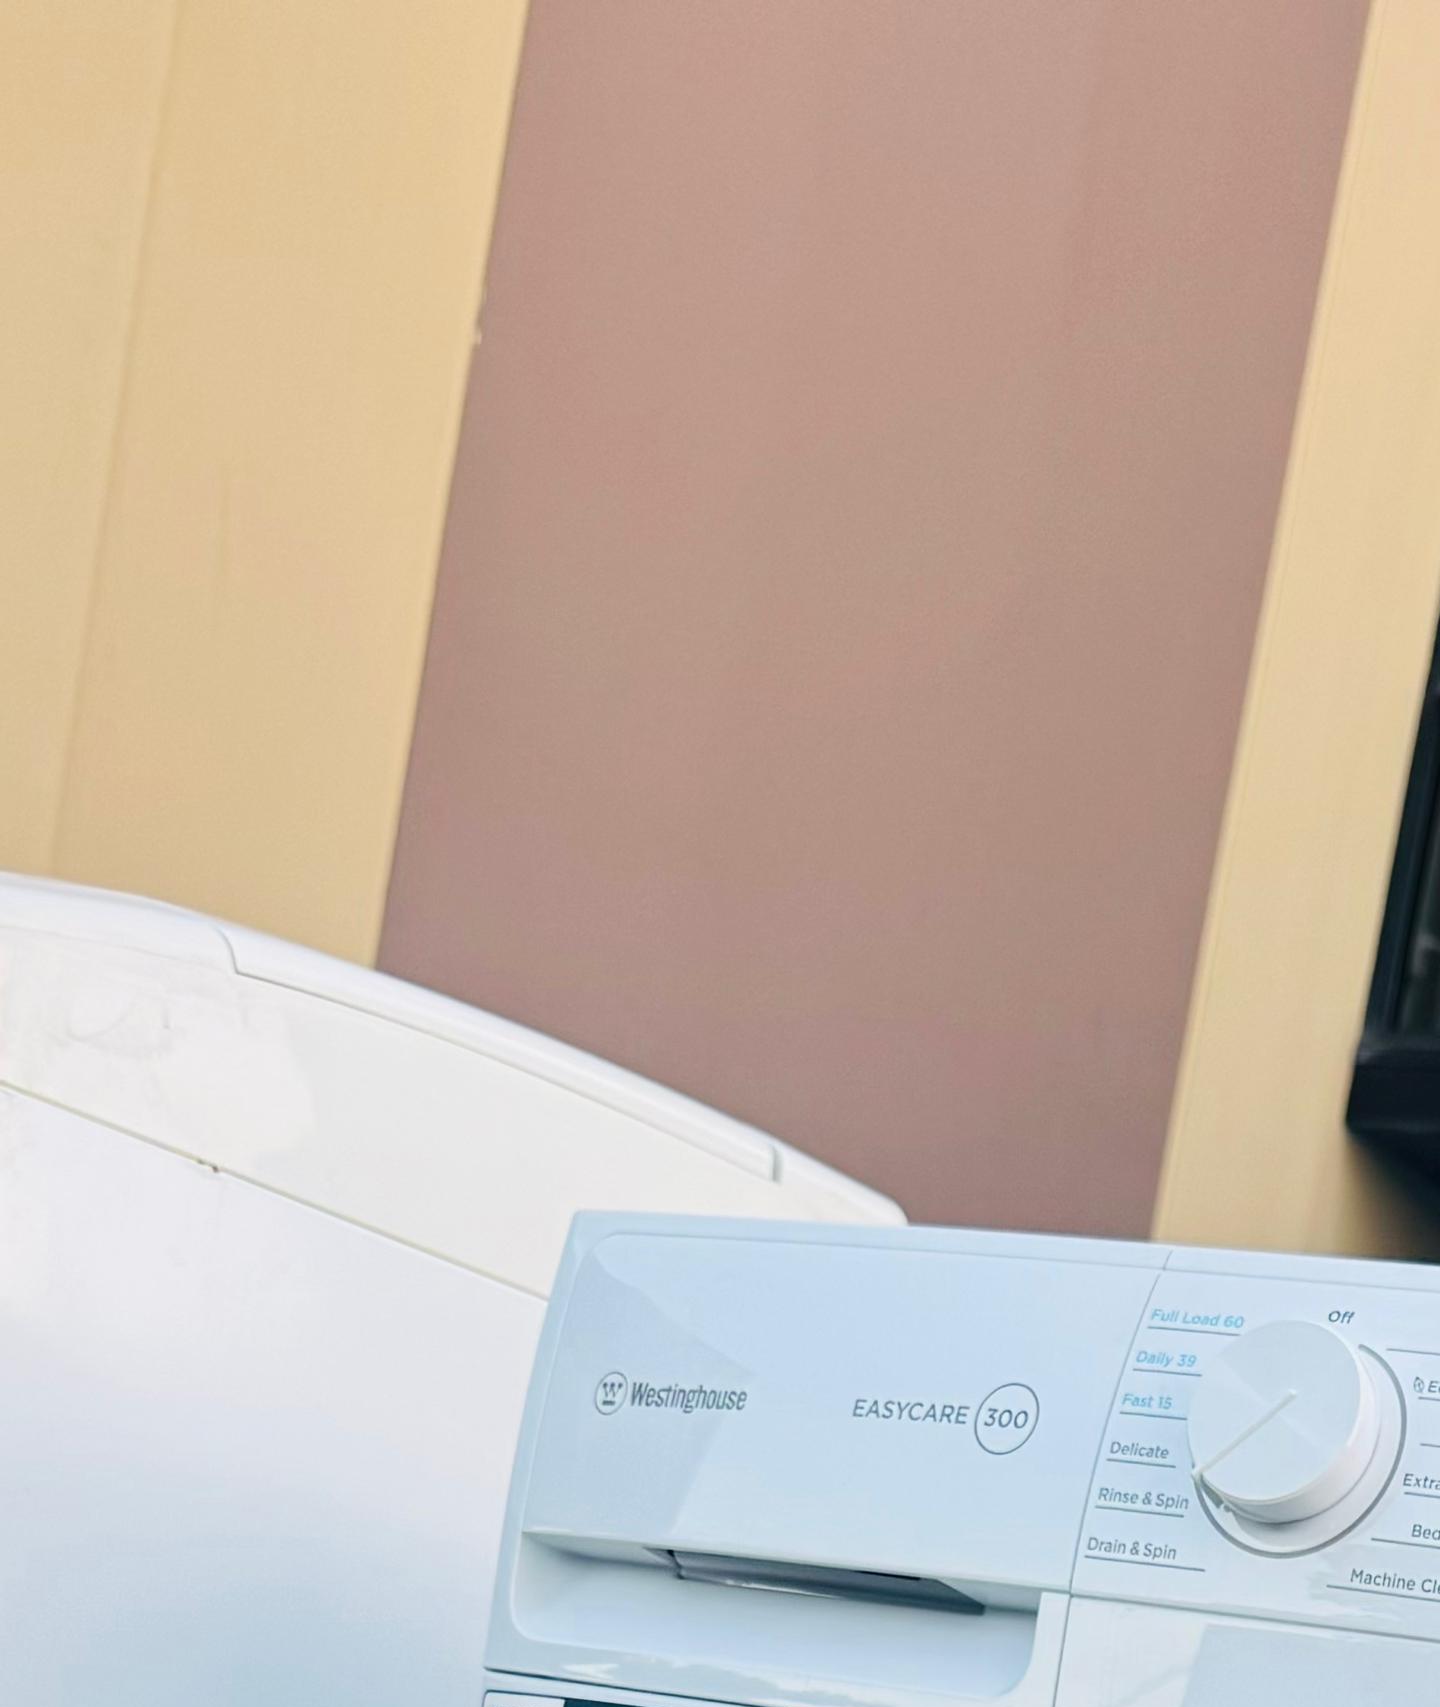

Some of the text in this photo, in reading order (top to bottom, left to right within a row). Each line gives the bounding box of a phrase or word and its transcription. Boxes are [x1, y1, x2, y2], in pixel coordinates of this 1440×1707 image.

[1150, 1308, 1245, 1329] Full Load 60
[1328, 1310, 1356, 1324] Off
[1135, 1350, 1197, 1368] Daily 39
[630, 1381, 748, 1414] Westinghouse
[1121, 1393, 1173, 1410] Fast 15
[852, 1399, 1029, 1429] EASYCARE 300
[1109, 1441, 1170, 1459] Delicate
[1098, 1487, 1190, 1510] Rinse & Spin
[1087, 1537, 1177, 1560] Drain & Spin
[1349, 1568, 1416, 1591] Machine
